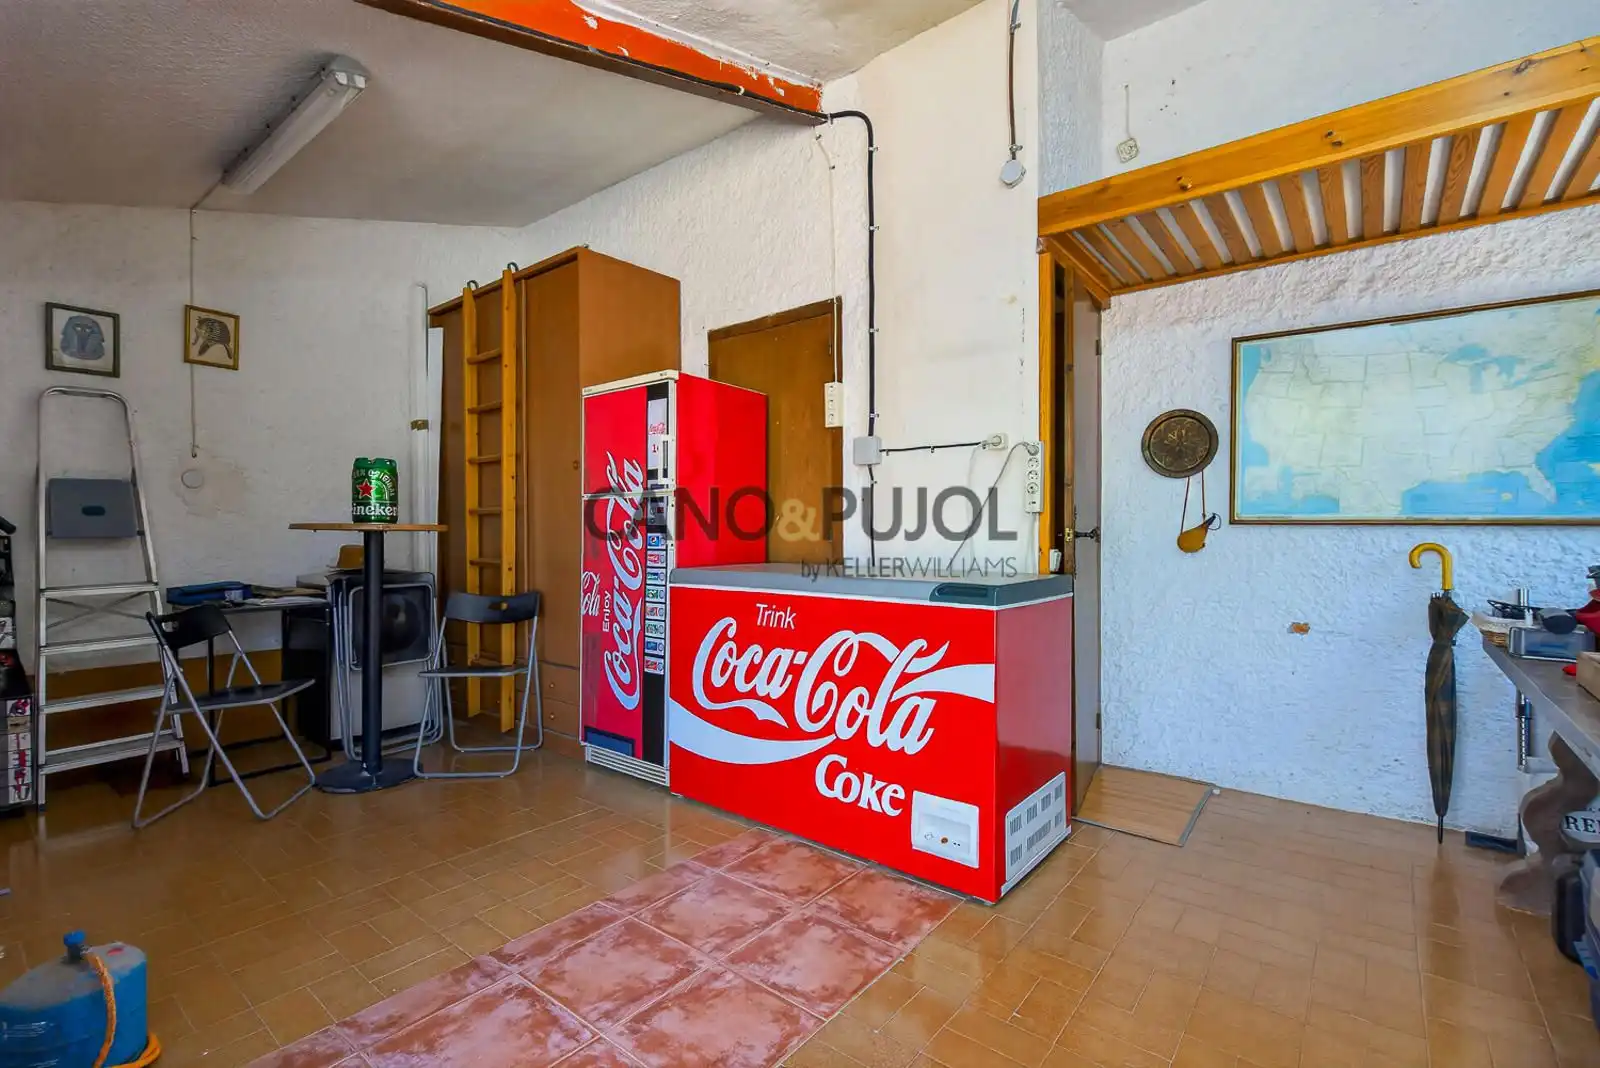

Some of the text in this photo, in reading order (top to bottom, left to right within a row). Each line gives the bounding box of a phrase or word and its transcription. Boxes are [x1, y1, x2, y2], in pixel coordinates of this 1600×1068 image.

[604, 451, 645, 711] Coca-Cola
[602, 590, 611, 632] Enjoy
[755, 603, 797, 630] Trink
[692, 616, 951, 756] Coca-Cola
[815, 753, 906, 817] Coke
[1564, 815, 1600, 834] RE
